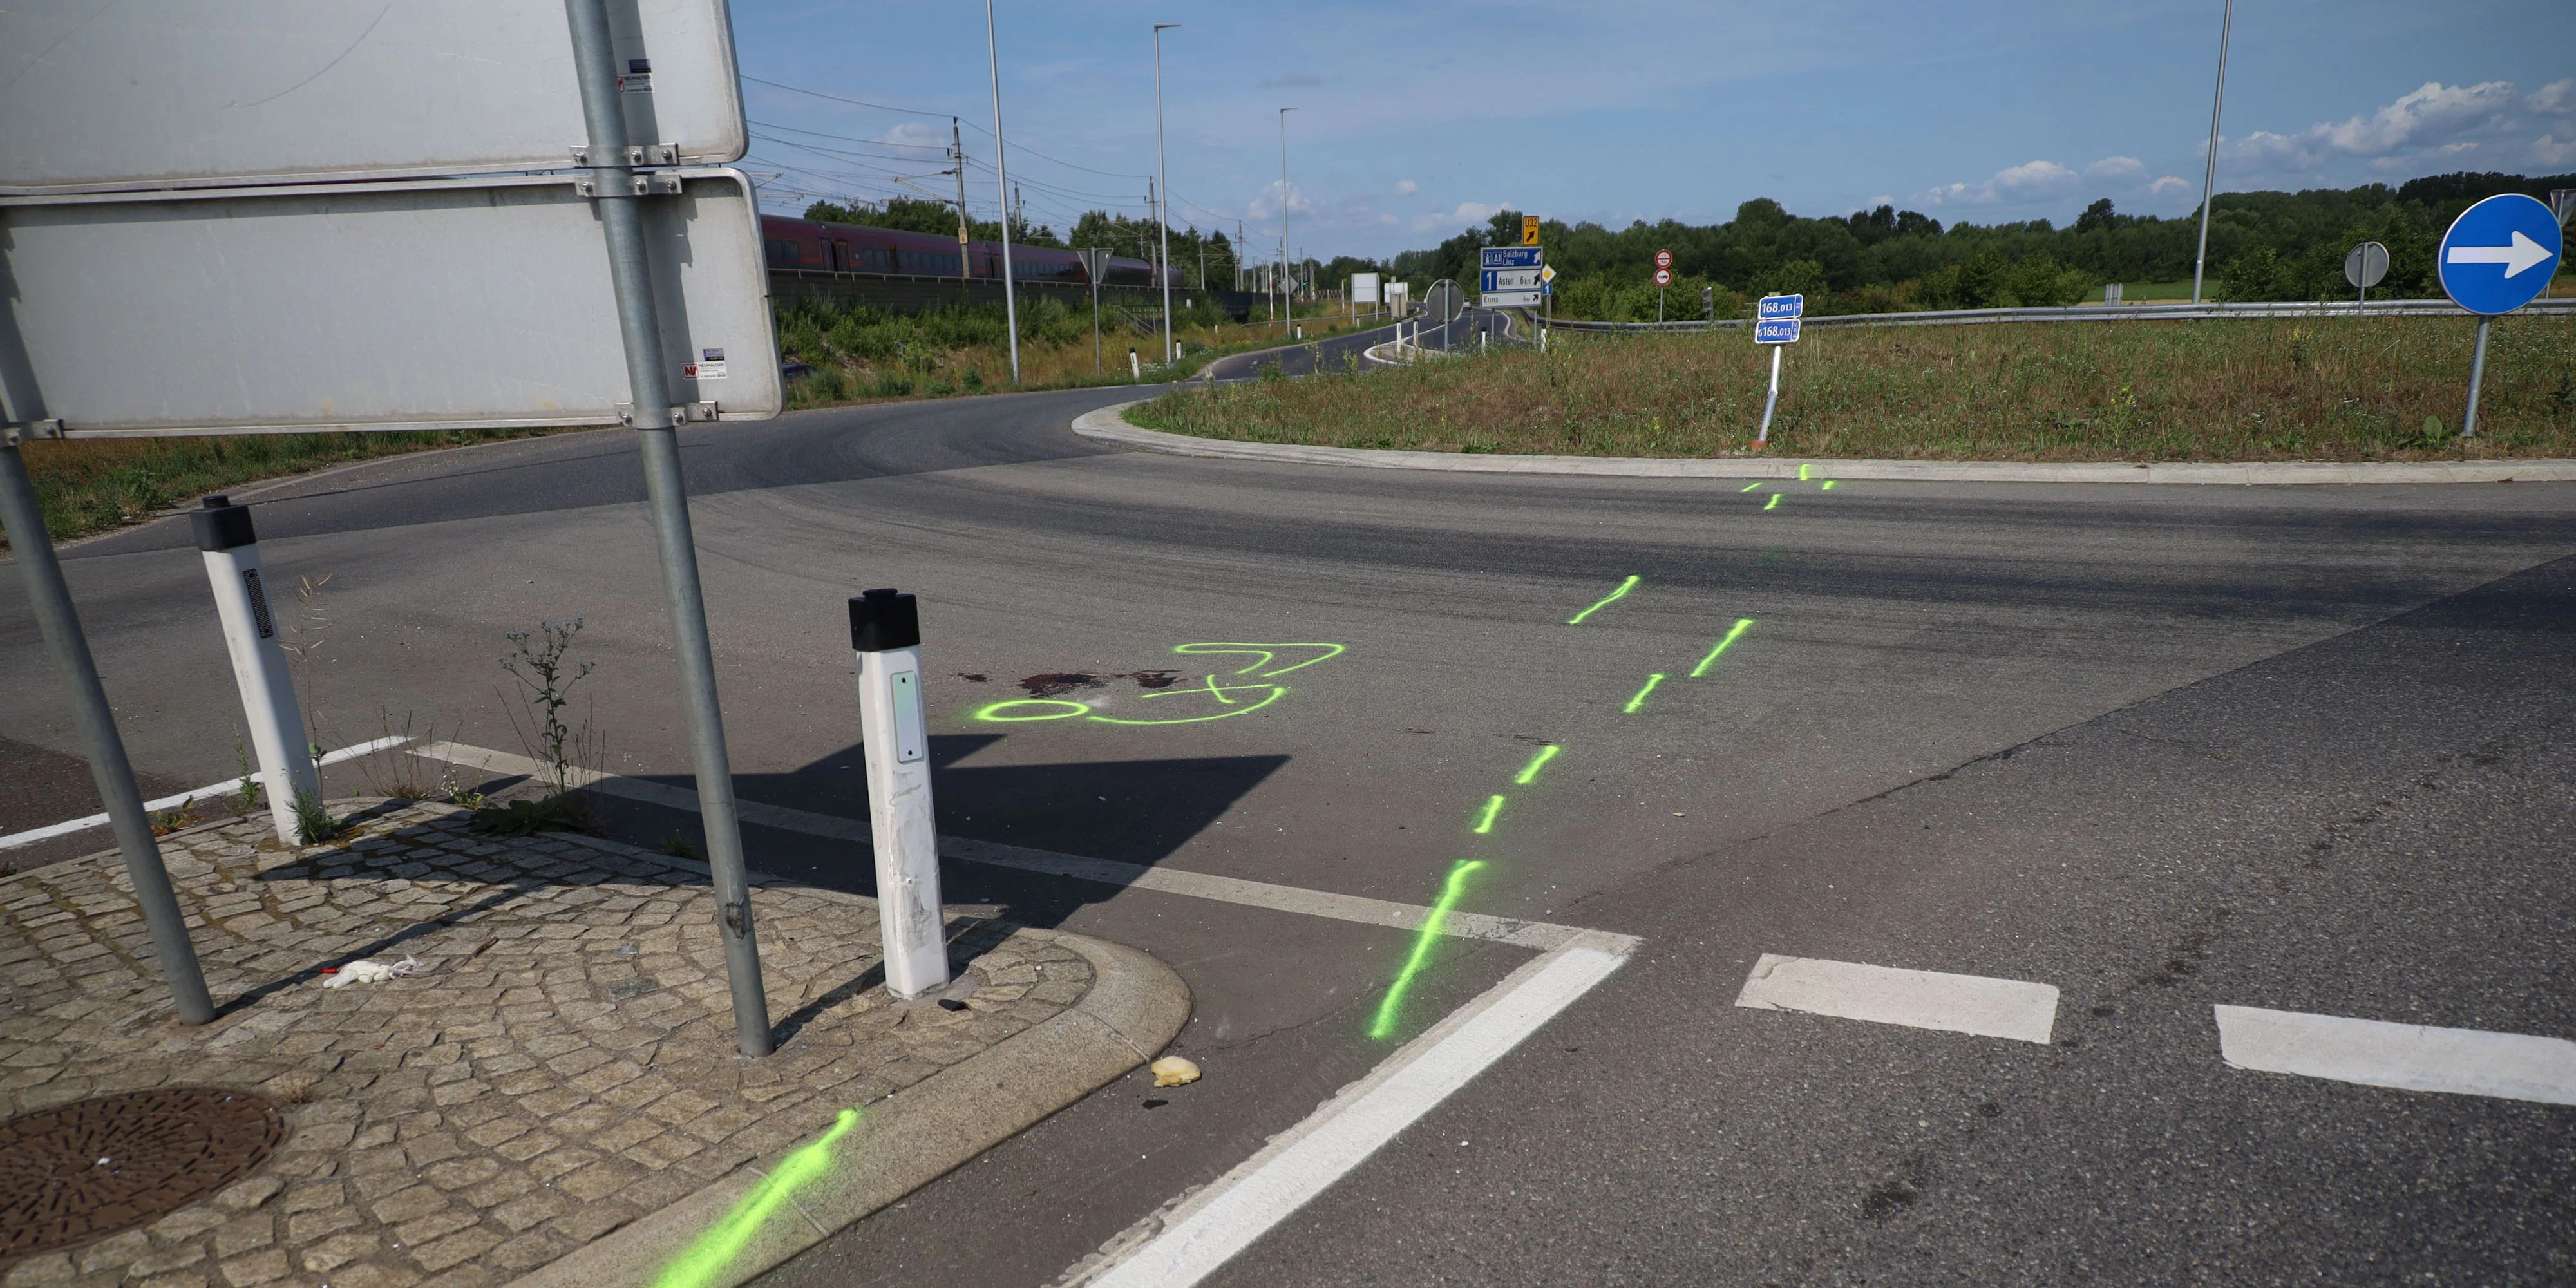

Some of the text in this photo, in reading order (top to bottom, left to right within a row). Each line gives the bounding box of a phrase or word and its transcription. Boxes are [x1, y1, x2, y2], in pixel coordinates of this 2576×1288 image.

[1525, 218, 1538, 227] U32
[1493, 254, 1501, 263] A1
[1502, 250, 1528, 258] Salzburg
[1486, 272, 1492, 290] 1
[1498, 277, 1514, 285] Asten
[1520, 276, 1524, 285] 6
[1545, 285, 1549, 294] 1
[1762, 302, 1792, 313] 168,013
